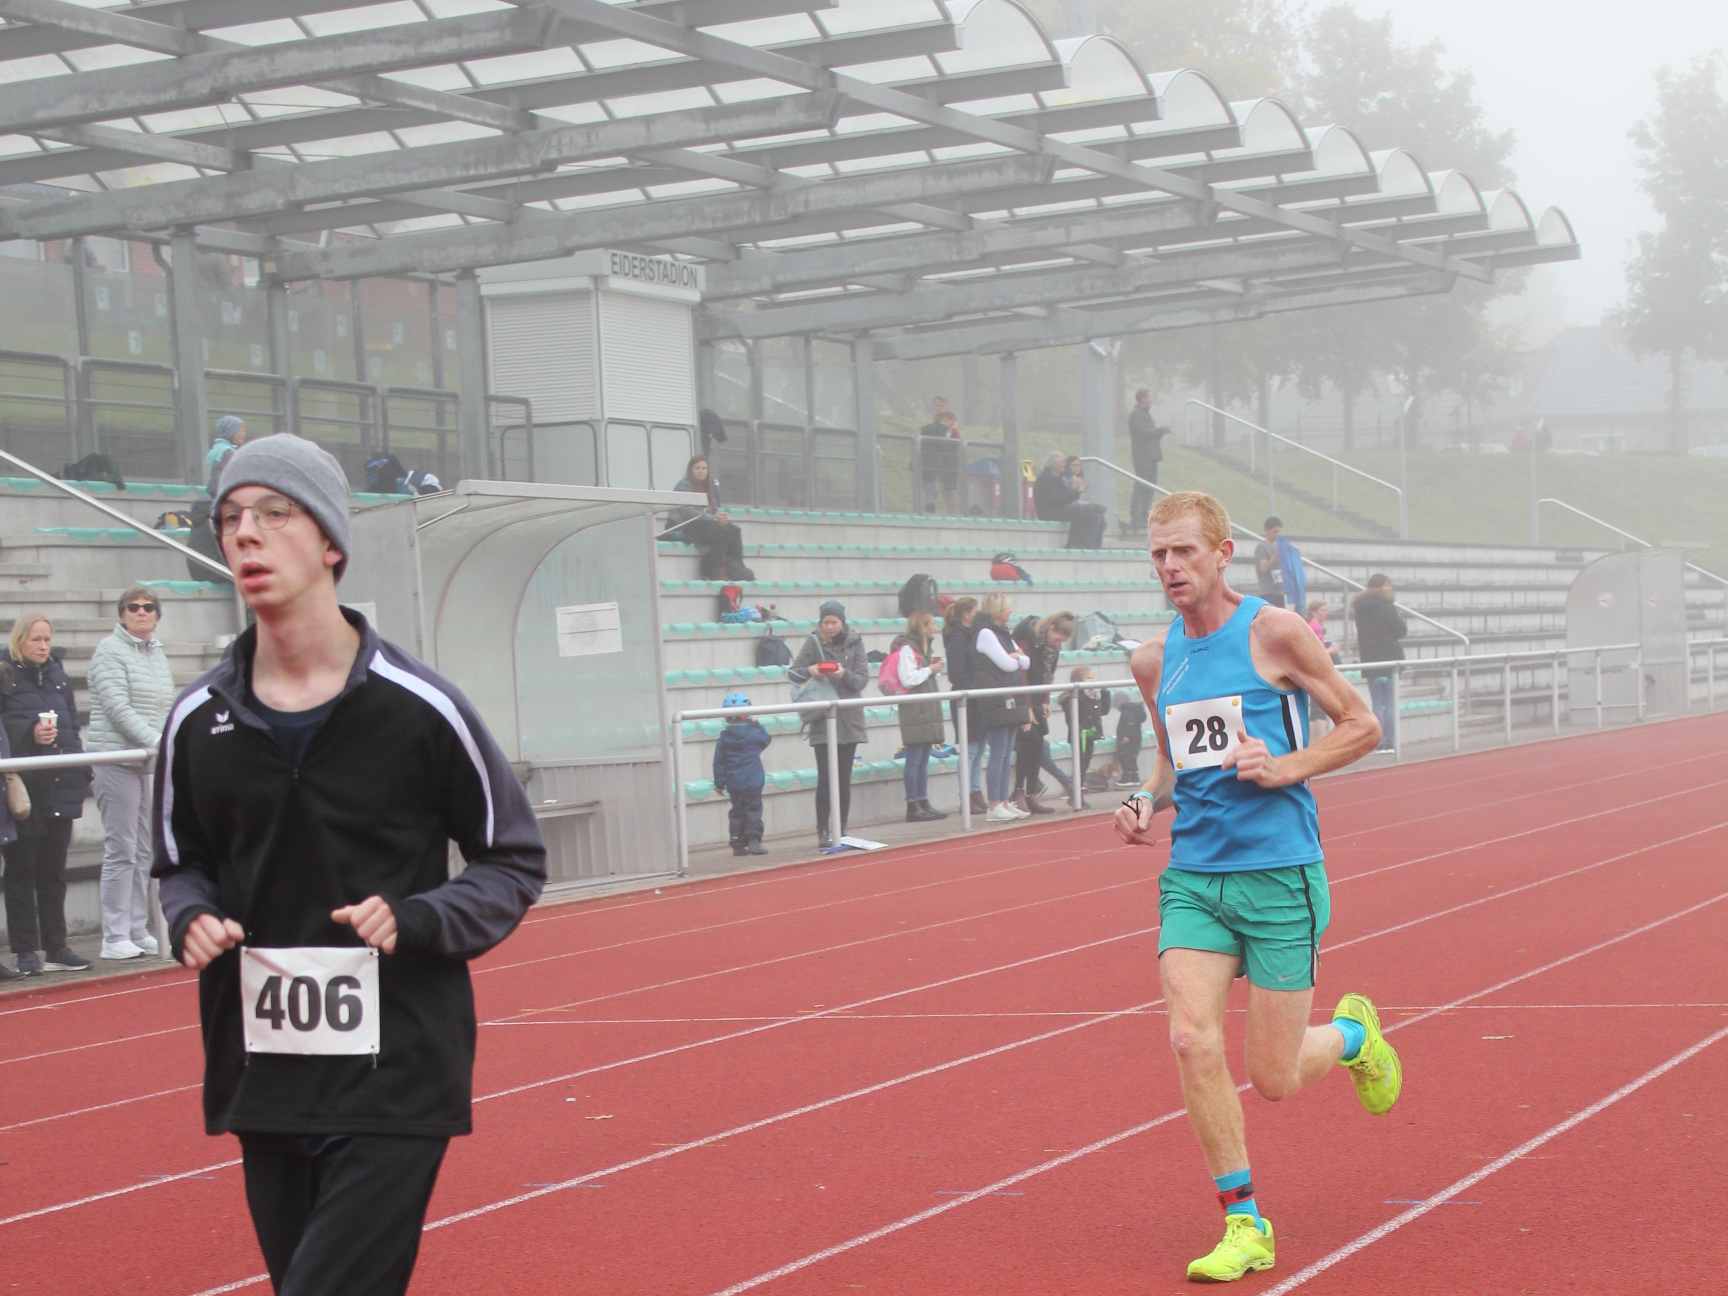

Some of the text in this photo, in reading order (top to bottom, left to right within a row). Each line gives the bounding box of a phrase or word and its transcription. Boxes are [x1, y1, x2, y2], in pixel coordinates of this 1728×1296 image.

[611, 252, 698, 288] EIDERSTADION
[1185, 715, 1229, 755] 28
[255, 975, 363, 1032] 406
